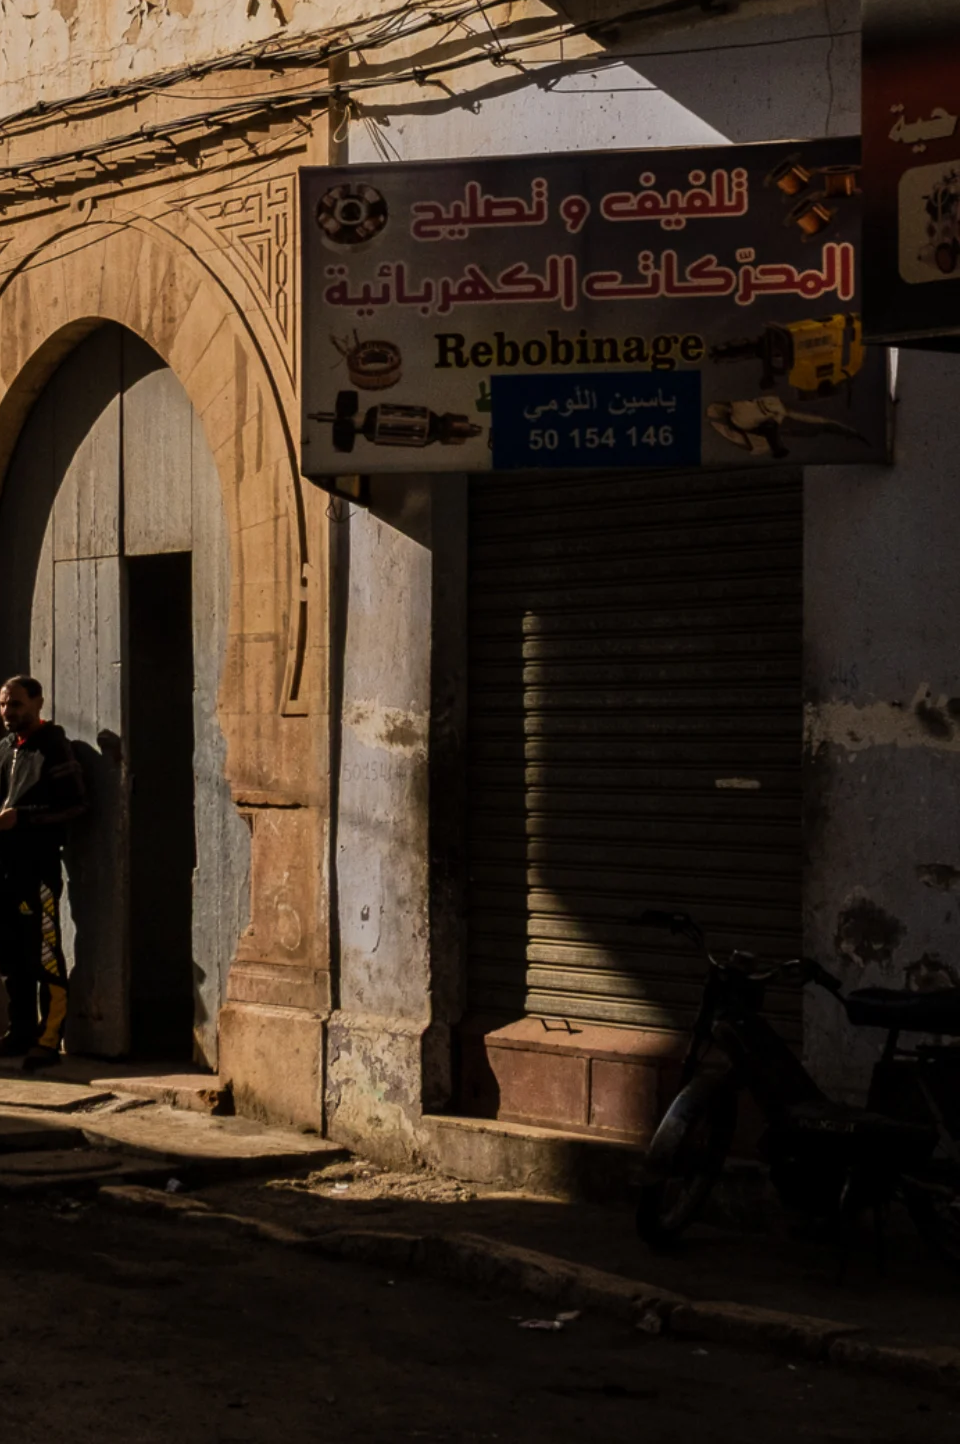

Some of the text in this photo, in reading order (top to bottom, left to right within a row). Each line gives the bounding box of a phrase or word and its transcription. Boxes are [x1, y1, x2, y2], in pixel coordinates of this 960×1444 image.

[410, 167, 748, 241] تلفيف و تصليح
[324, 256, 578, 317] الكهربائية
[433, 329, 704, 372] Rebobinage
[608, 389, 678, 415] ياسين
[528, 424, 675, 452] 50 154 146
